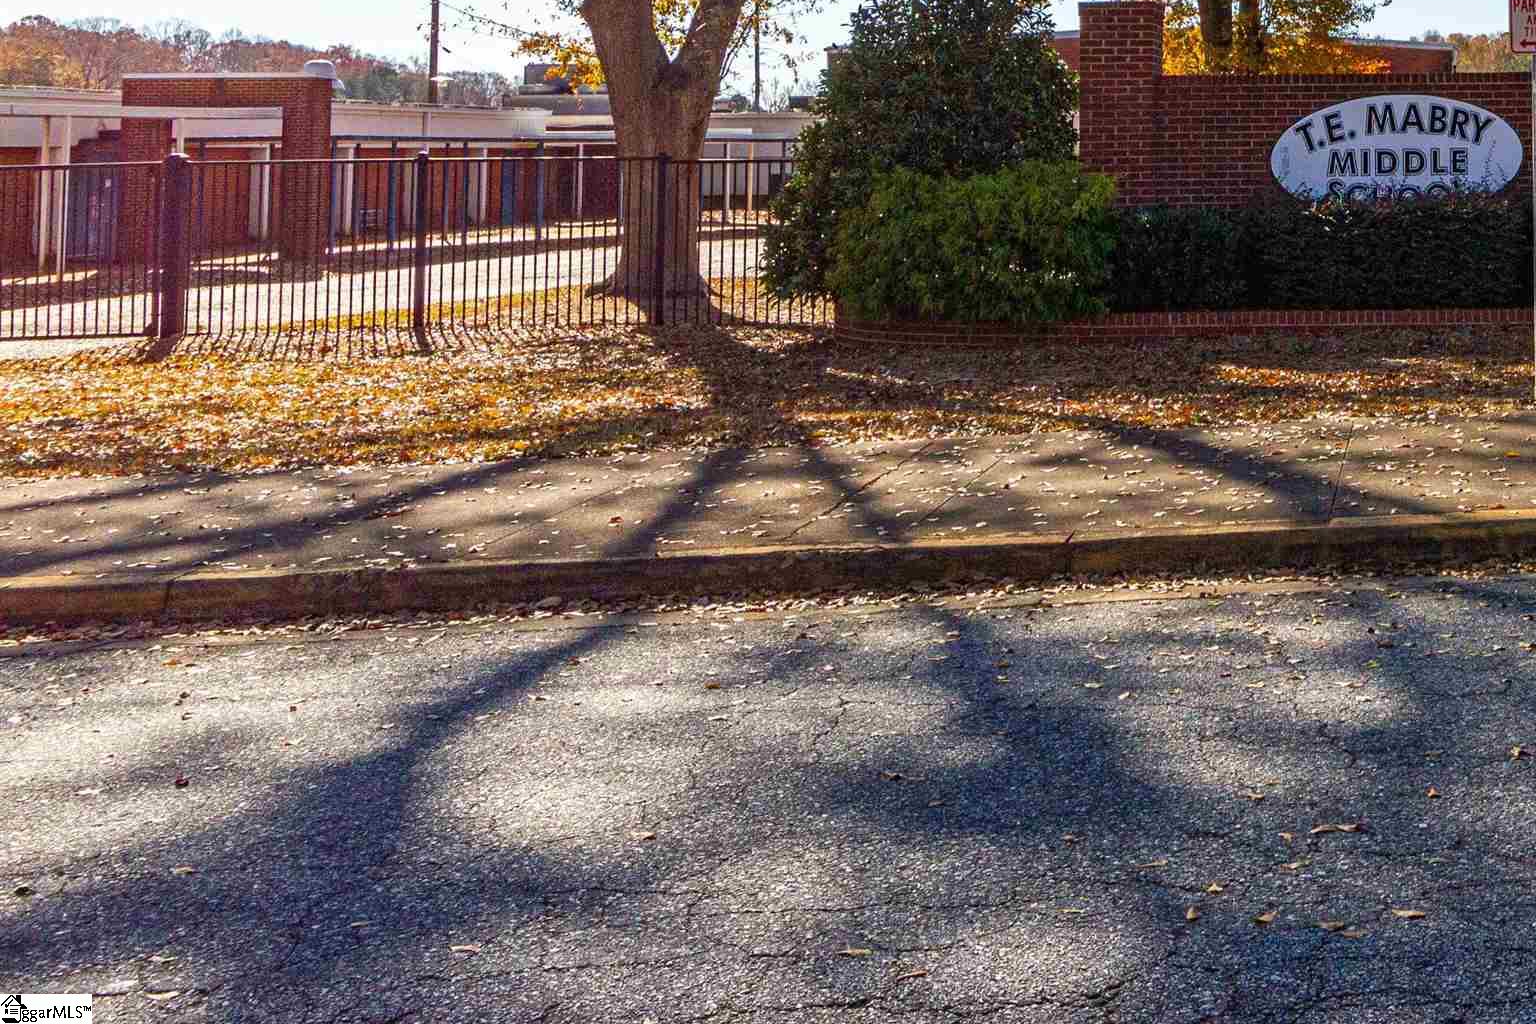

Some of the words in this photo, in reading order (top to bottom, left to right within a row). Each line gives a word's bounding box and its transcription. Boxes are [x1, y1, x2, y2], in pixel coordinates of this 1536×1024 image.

[1294, 111, 1357, 154] T.E.
[1364, 101, 1496, 146] MABRY
[1328, 147, 1469, 176] MIDDLE
